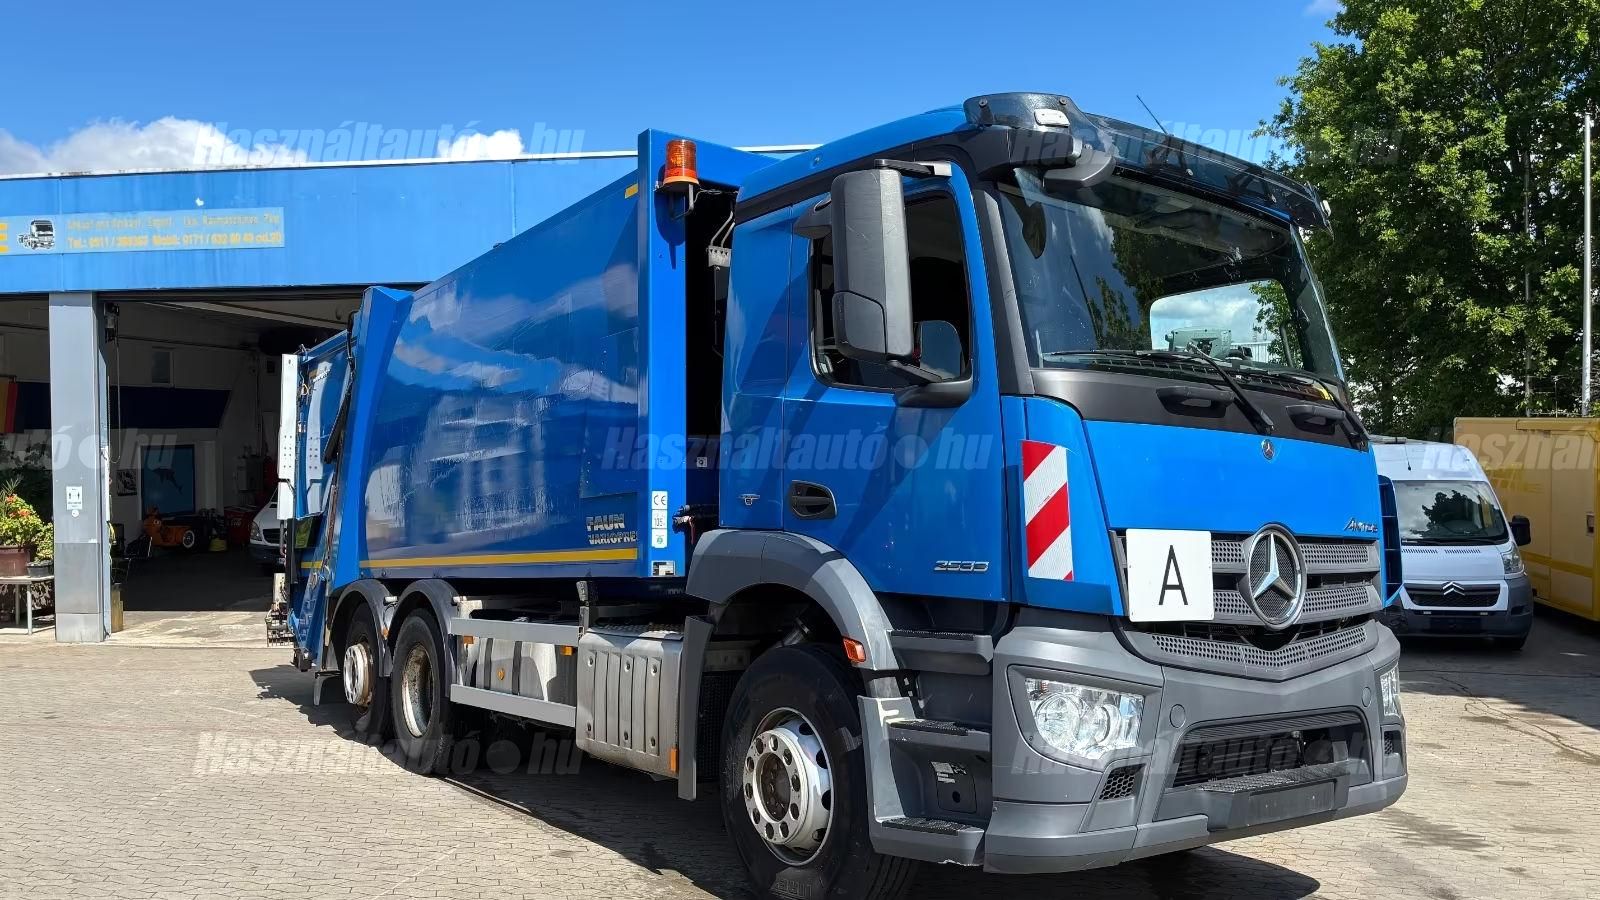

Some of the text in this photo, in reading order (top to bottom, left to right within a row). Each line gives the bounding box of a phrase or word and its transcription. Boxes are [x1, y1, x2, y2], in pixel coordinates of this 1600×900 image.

[586, 513, 626, 531] FAUN
[934, 560, 990, 573] 2533
[1158, 544, 1188, 606] A
